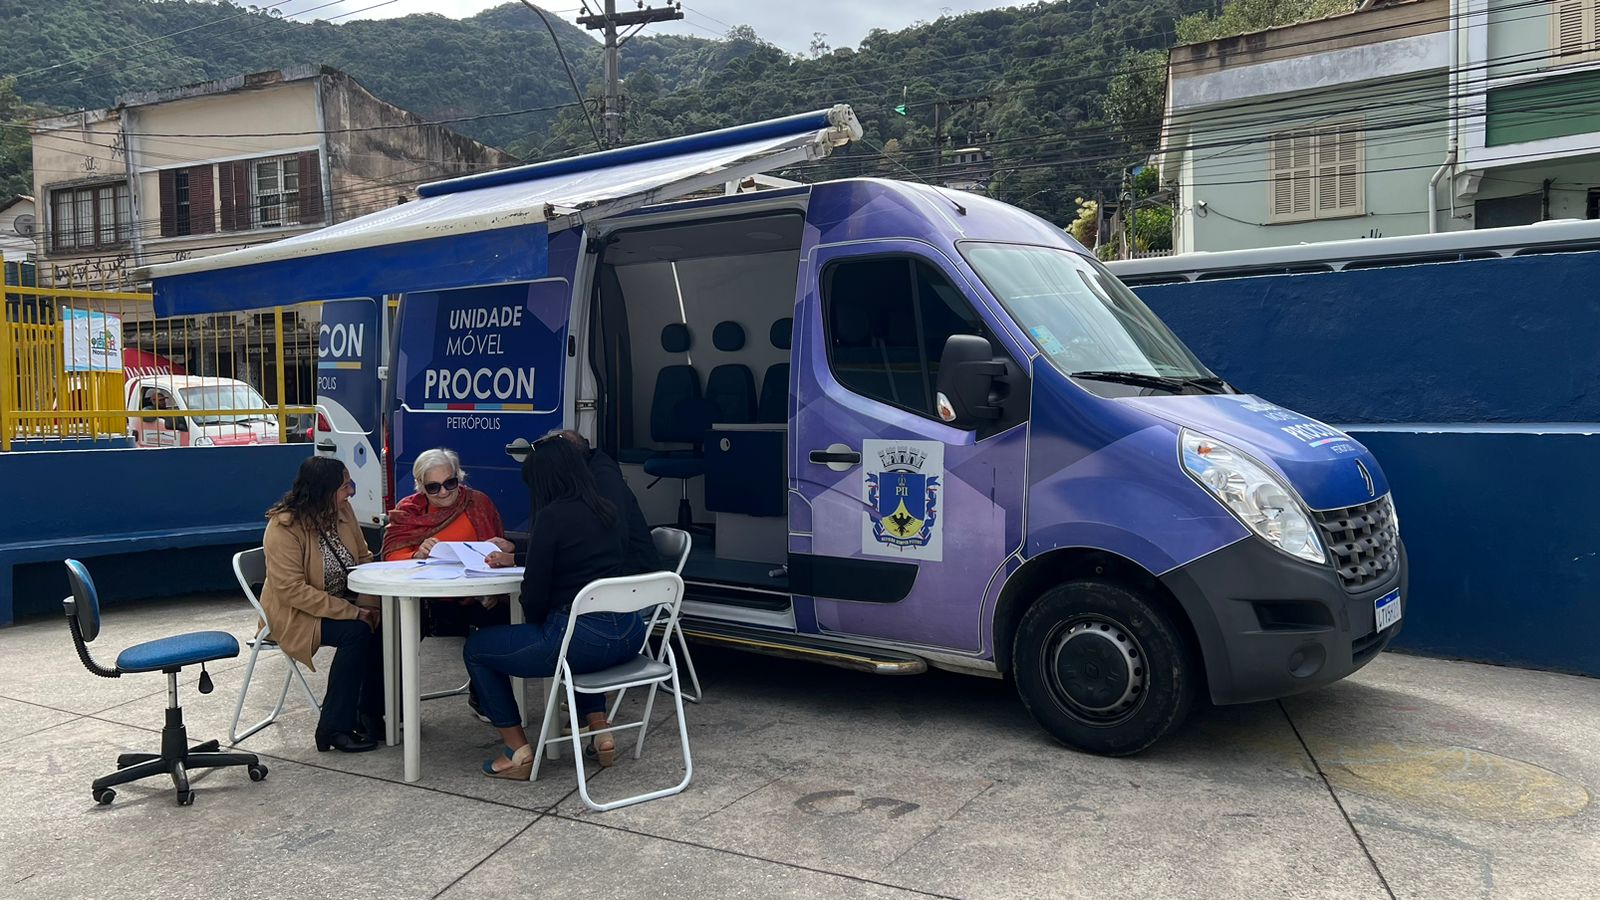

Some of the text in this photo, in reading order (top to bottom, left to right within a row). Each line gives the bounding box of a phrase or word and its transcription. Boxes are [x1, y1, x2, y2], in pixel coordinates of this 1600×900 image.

[449, 306, 523, 330] UNIDADE
[318, 323, 364, 358] CON
[446, 330, 504, 356] MÓVEL
[424, 367, 536, 400] PROCON
[446, 414, 501, 430] PETRÓPOLIS
